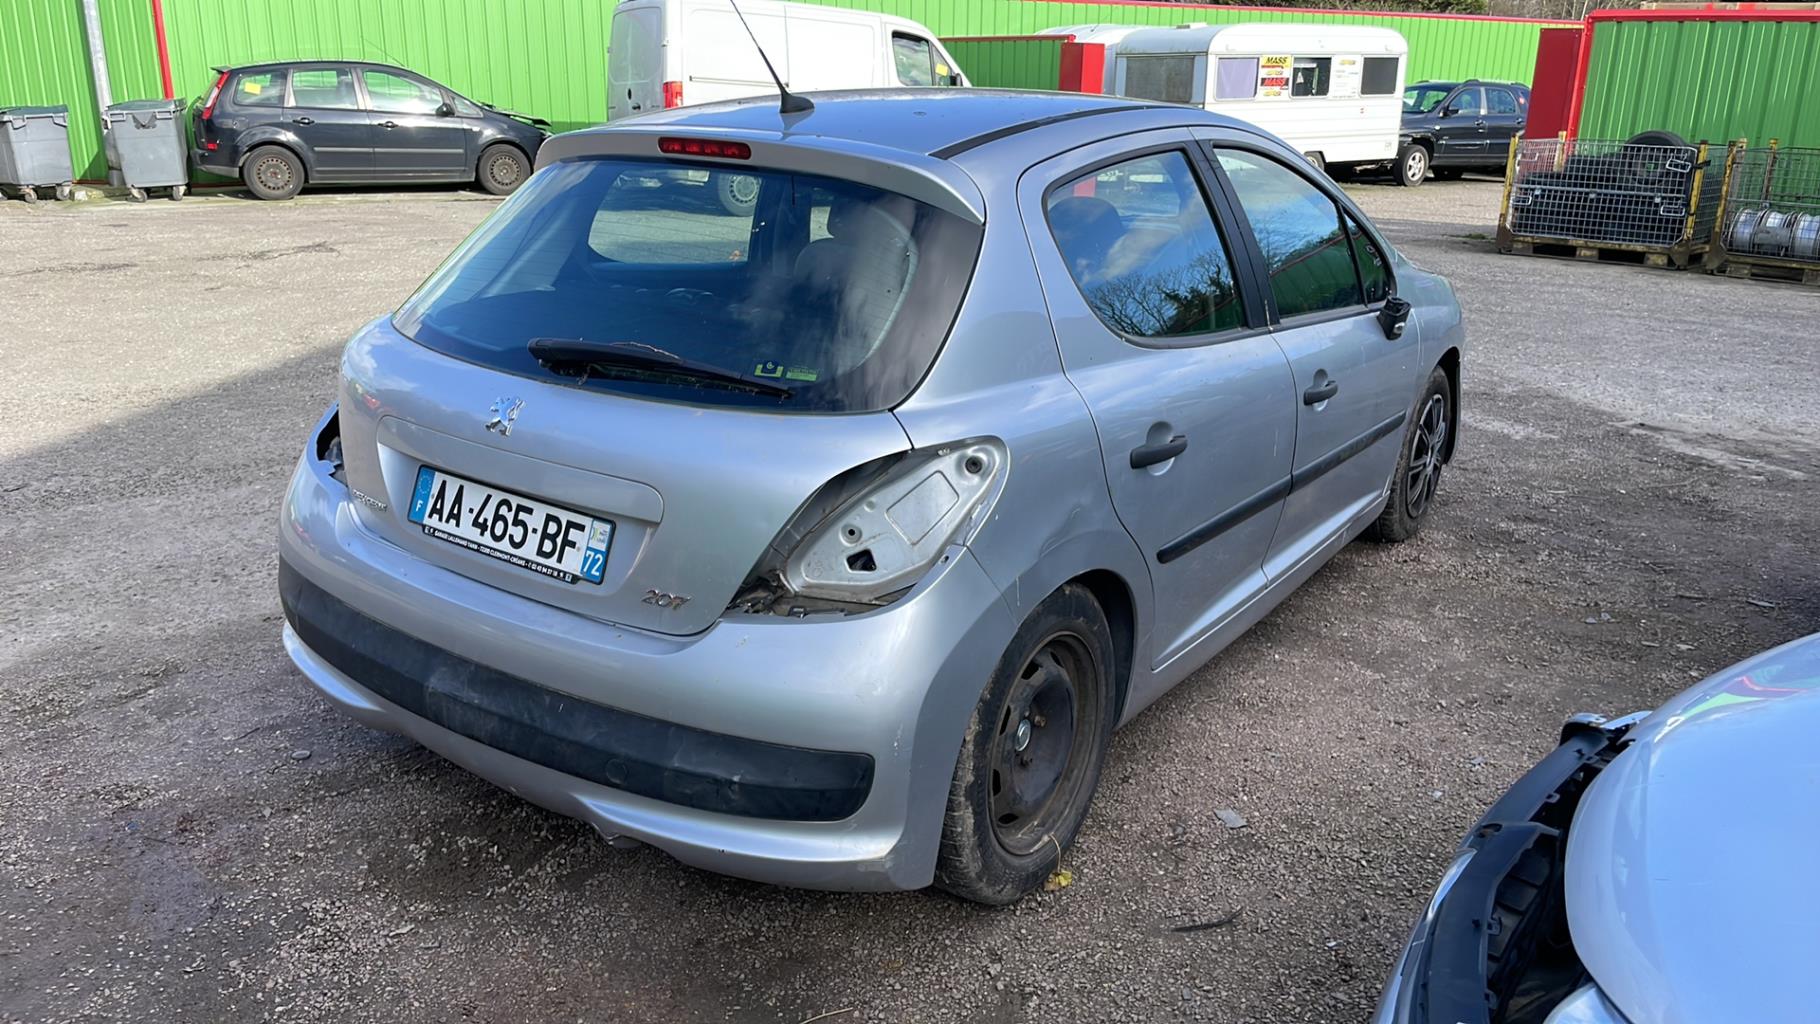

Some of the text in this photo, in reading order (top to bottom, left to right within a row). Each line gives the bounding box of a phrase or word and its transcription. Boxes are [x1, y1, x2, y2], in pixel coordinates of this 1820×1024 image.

[1265, 57, 1288, 65] MASS
[415, 500, 424, 512] F
[427, 479, 586, 564] AA-465-BF
[583, 550, 603, 576] 72
[641, 589, 692, 611] 207
